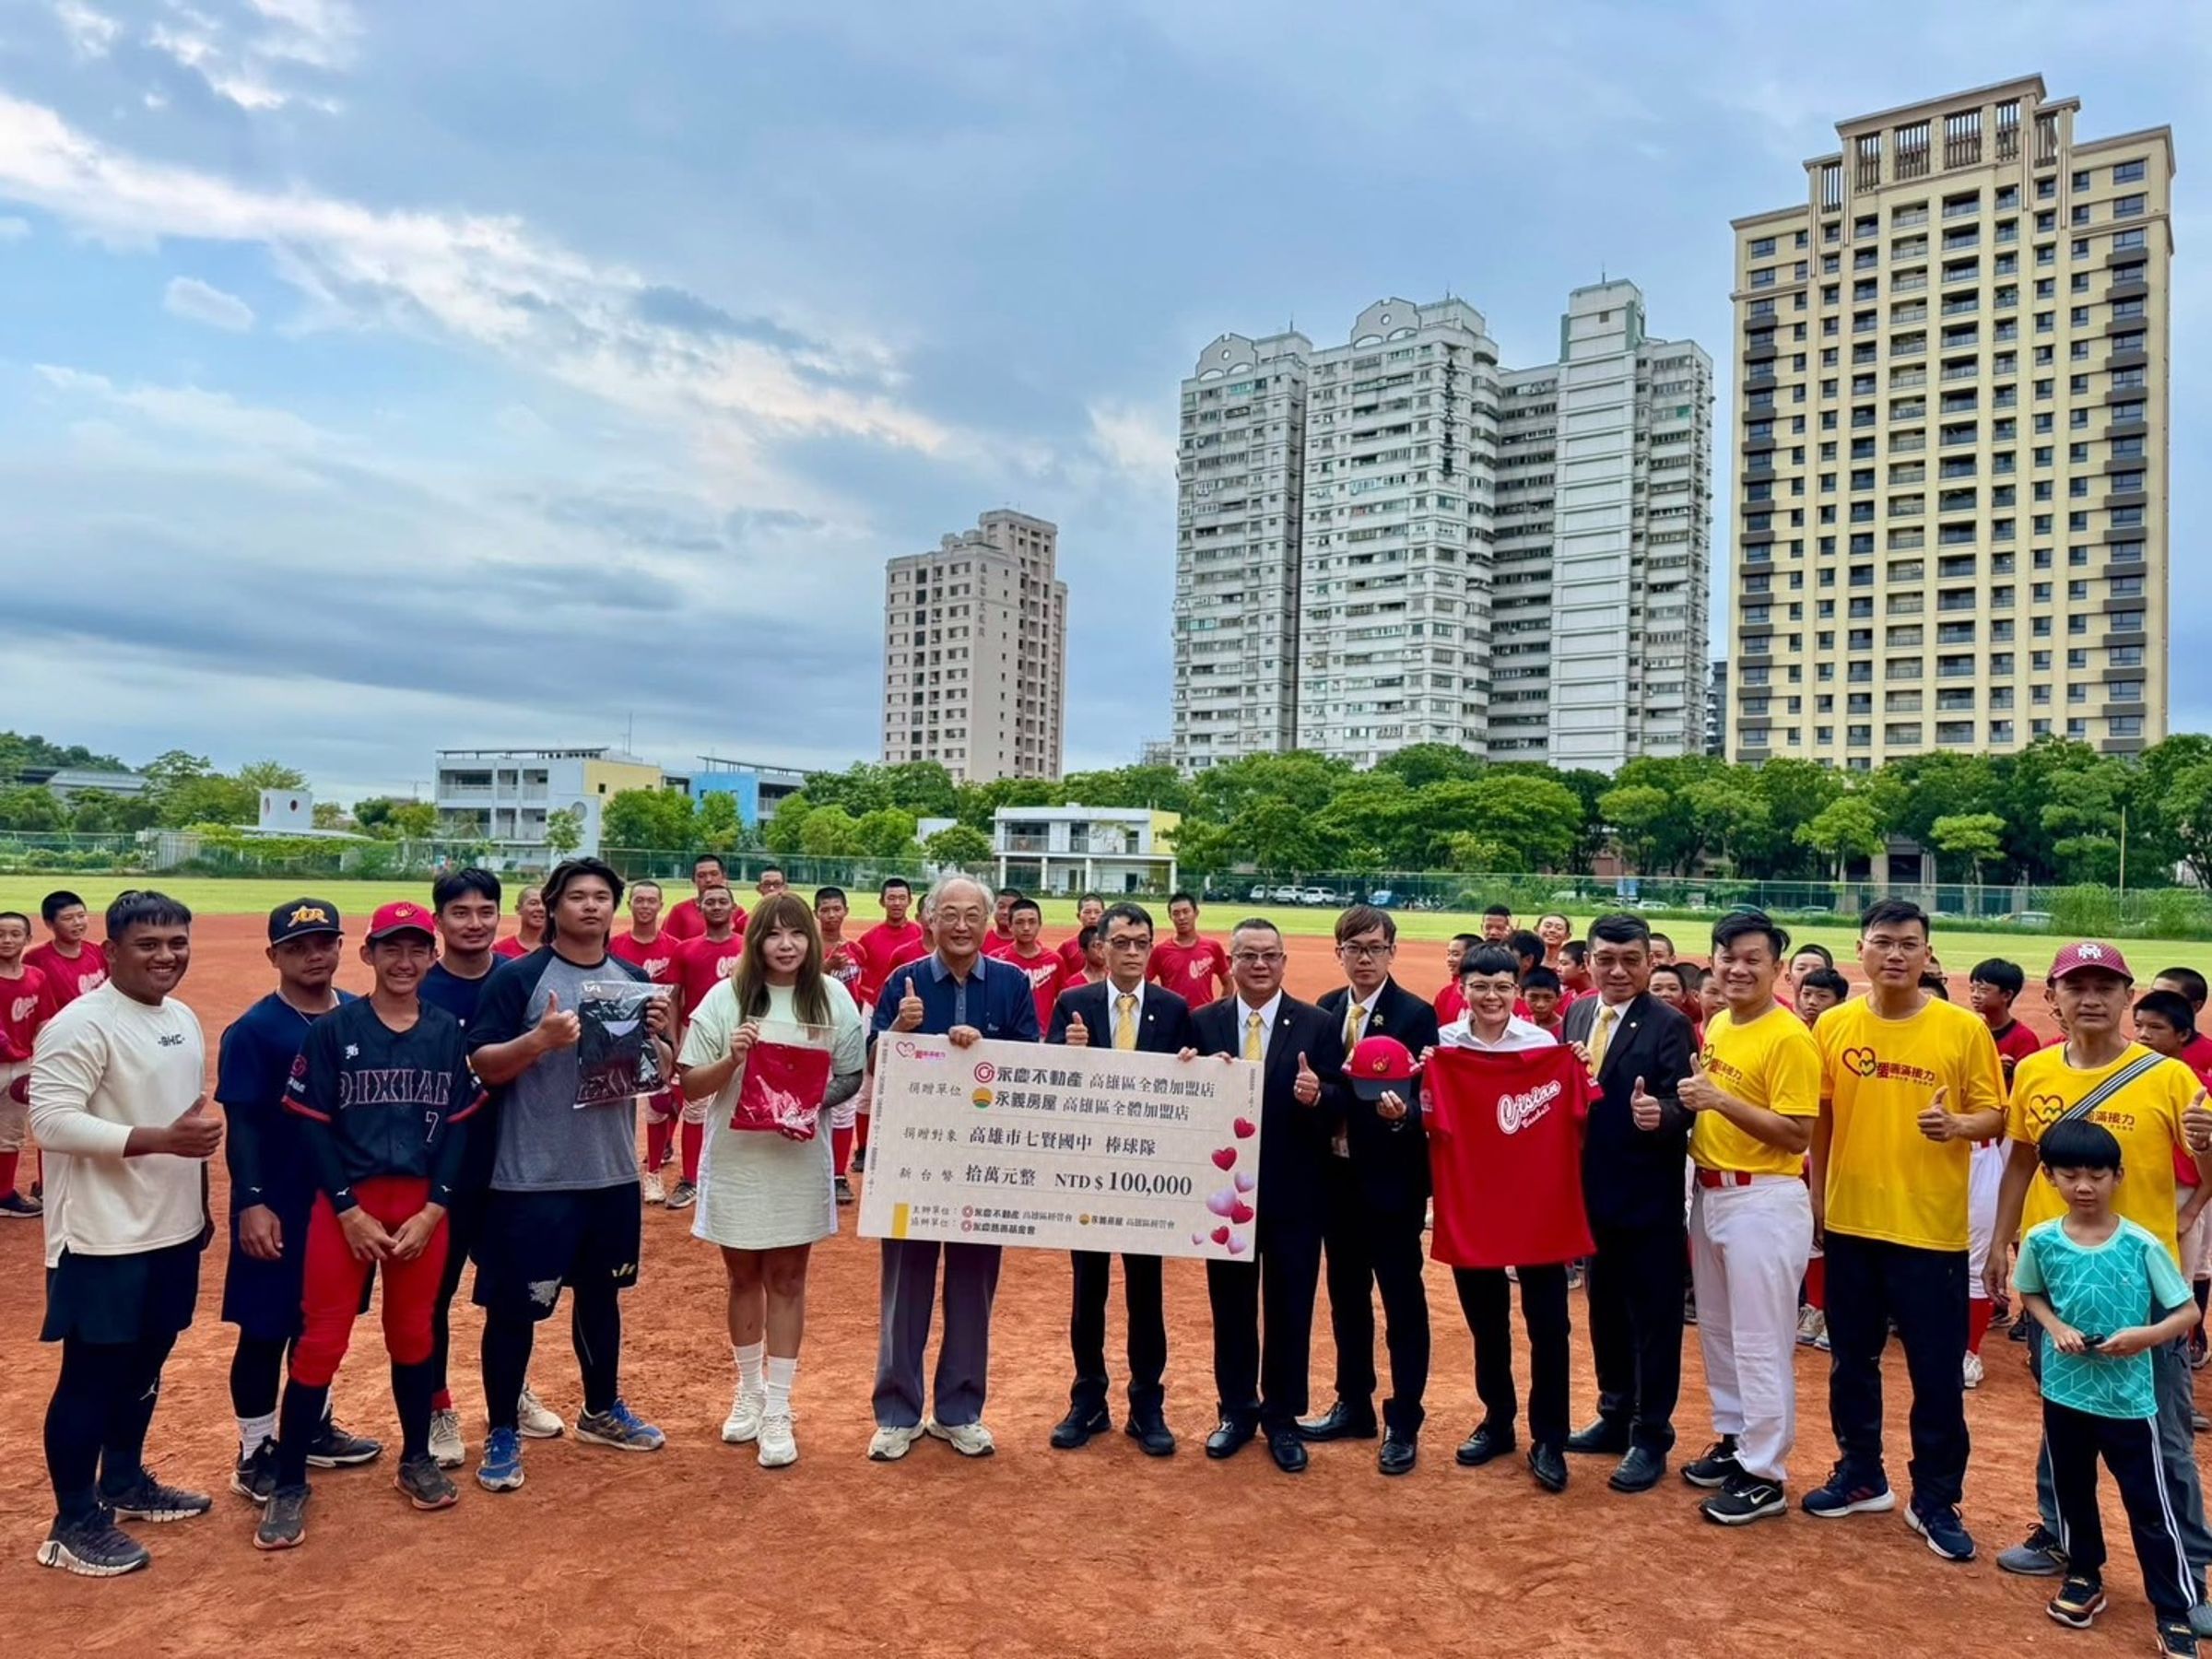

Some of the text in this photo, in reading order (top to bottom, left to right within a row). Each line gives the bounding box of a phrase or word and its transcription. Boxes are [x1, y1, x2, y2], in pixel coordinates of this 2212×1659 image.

[908, 1081, 962, 1097] 捐贈單位
[996, 1066, 1215, 1098] 永慶不動產 高雄區全體加盟店
[994, 1090, 1190, 1121] 永義房屋 高雄區全體加盟店
[425, 1111, 440, 1143] 7
[902, 1126, 958, 1142] 捐贈對象
[970, 1125, 1156, 1156] 高雄市七賢國中 棒球隊
[966, 1164, 1036, 1187] 拾萬元整
[1054, 1173, 1091, 1189] NTD
